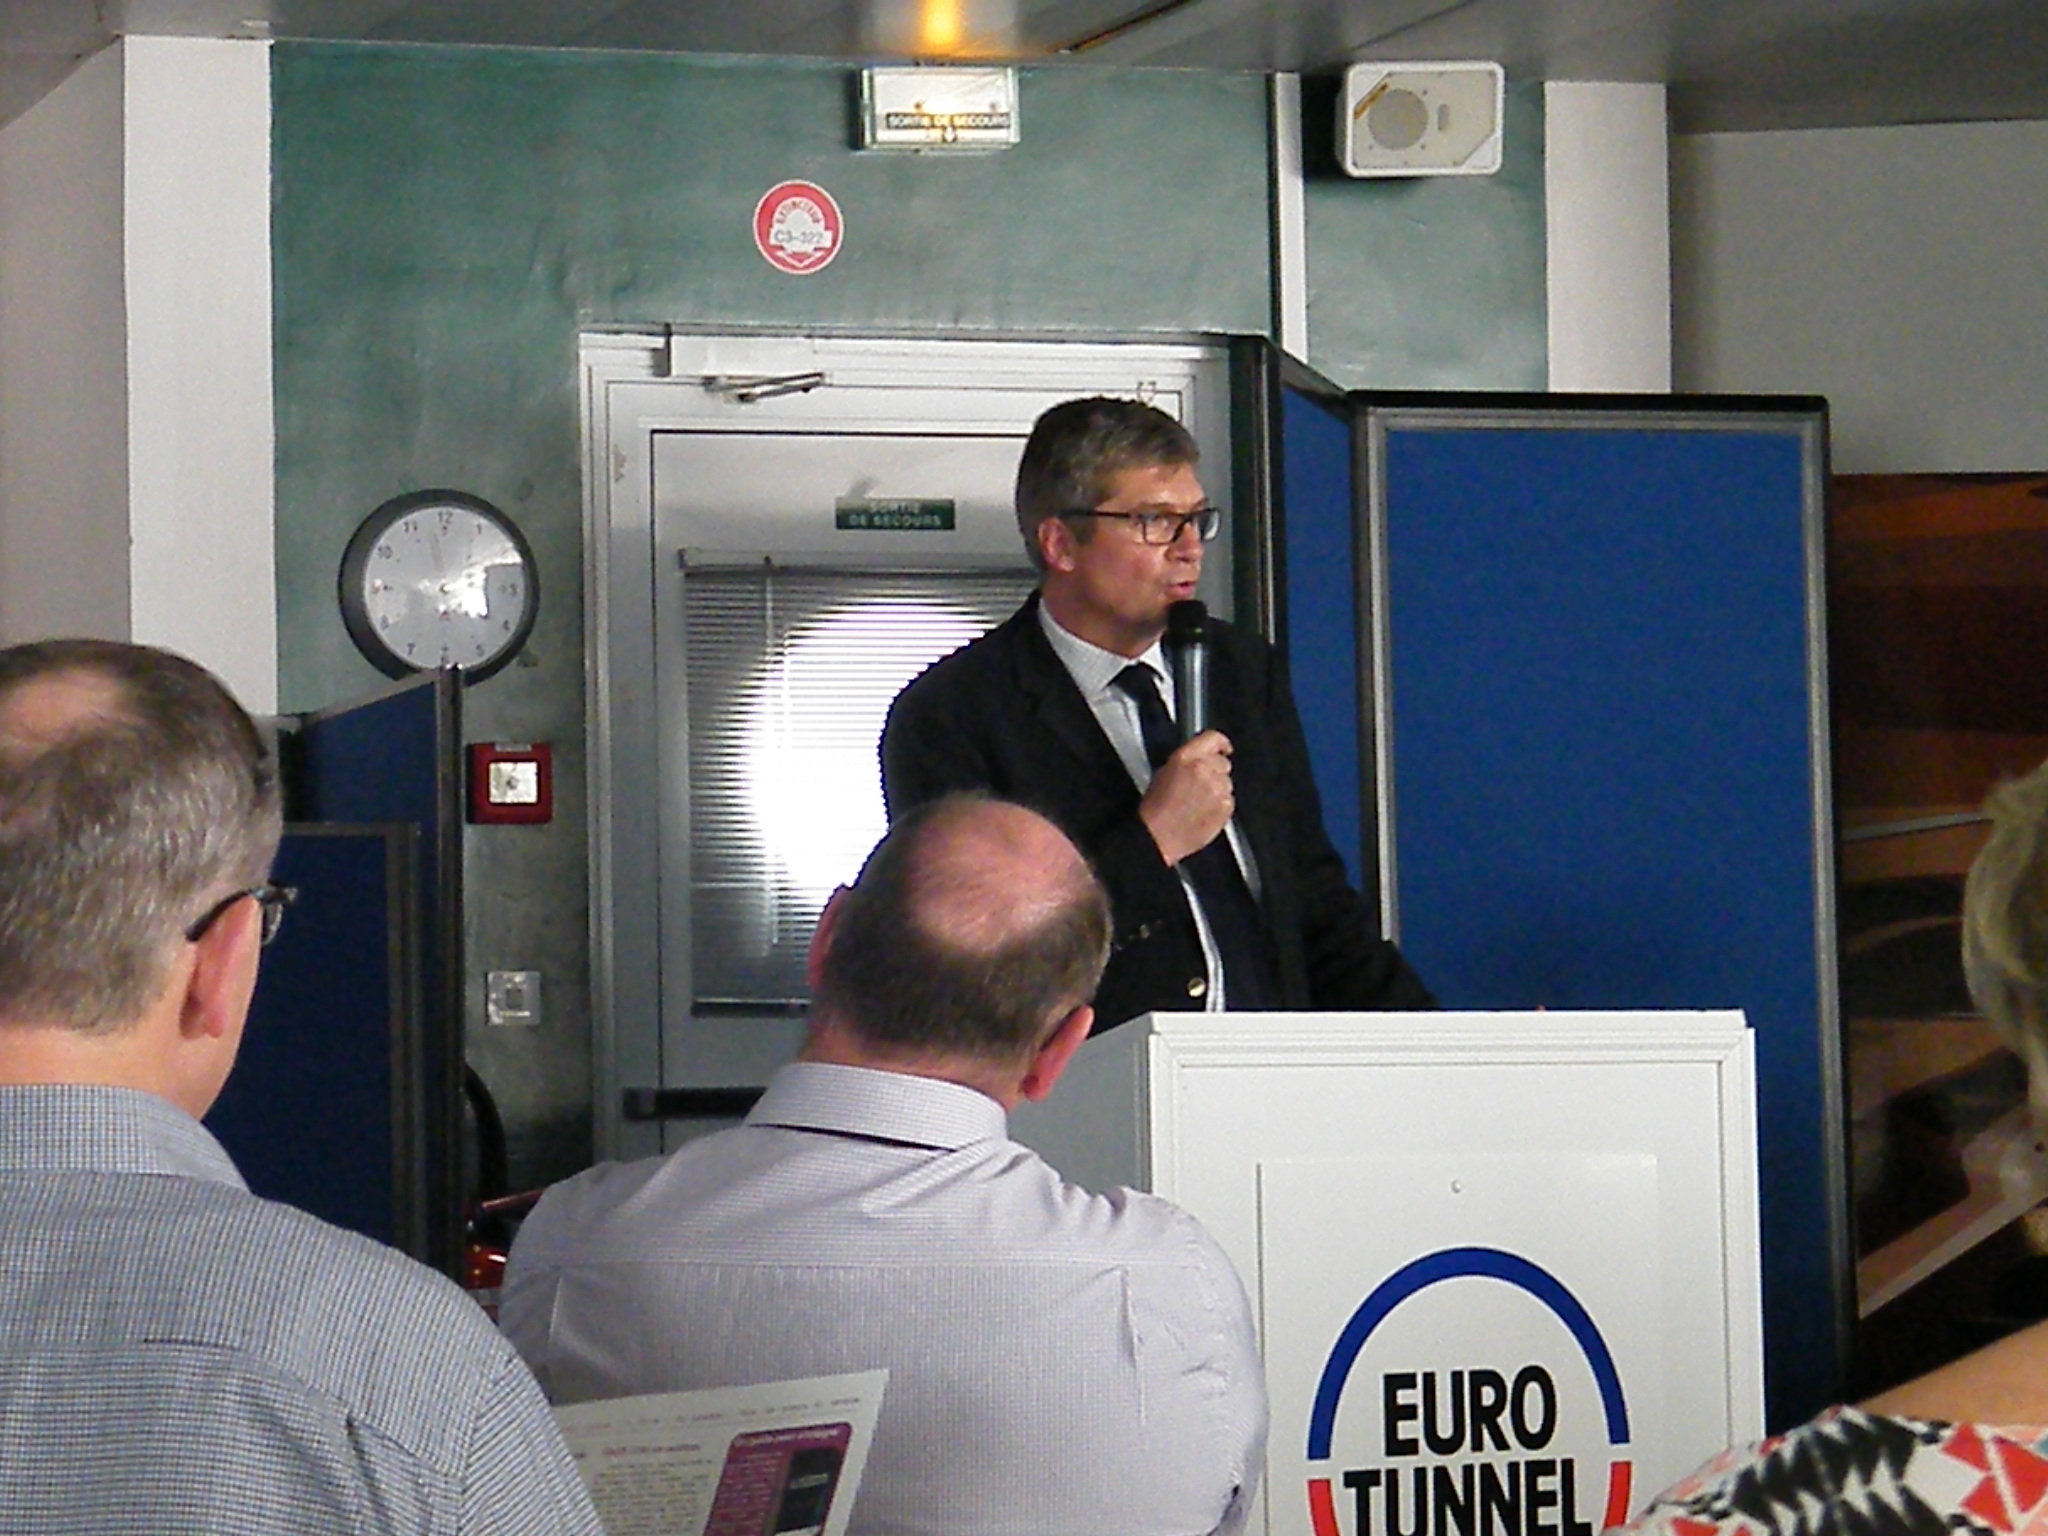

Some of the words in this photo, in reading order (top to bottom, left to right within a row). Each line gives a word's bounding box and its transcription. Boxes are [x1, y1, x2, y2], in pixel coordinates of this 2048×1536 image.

[953, 114, 1010, 128] SECOURS
[437, 511, 454, 524] 12
[873, 515, 941, 526] SECOURS
[377, 545, 393, 560] 10
[1384, 1365, 1557, 1457] EURO
[1343, 1458, 1593, 1536] TUNNEL
